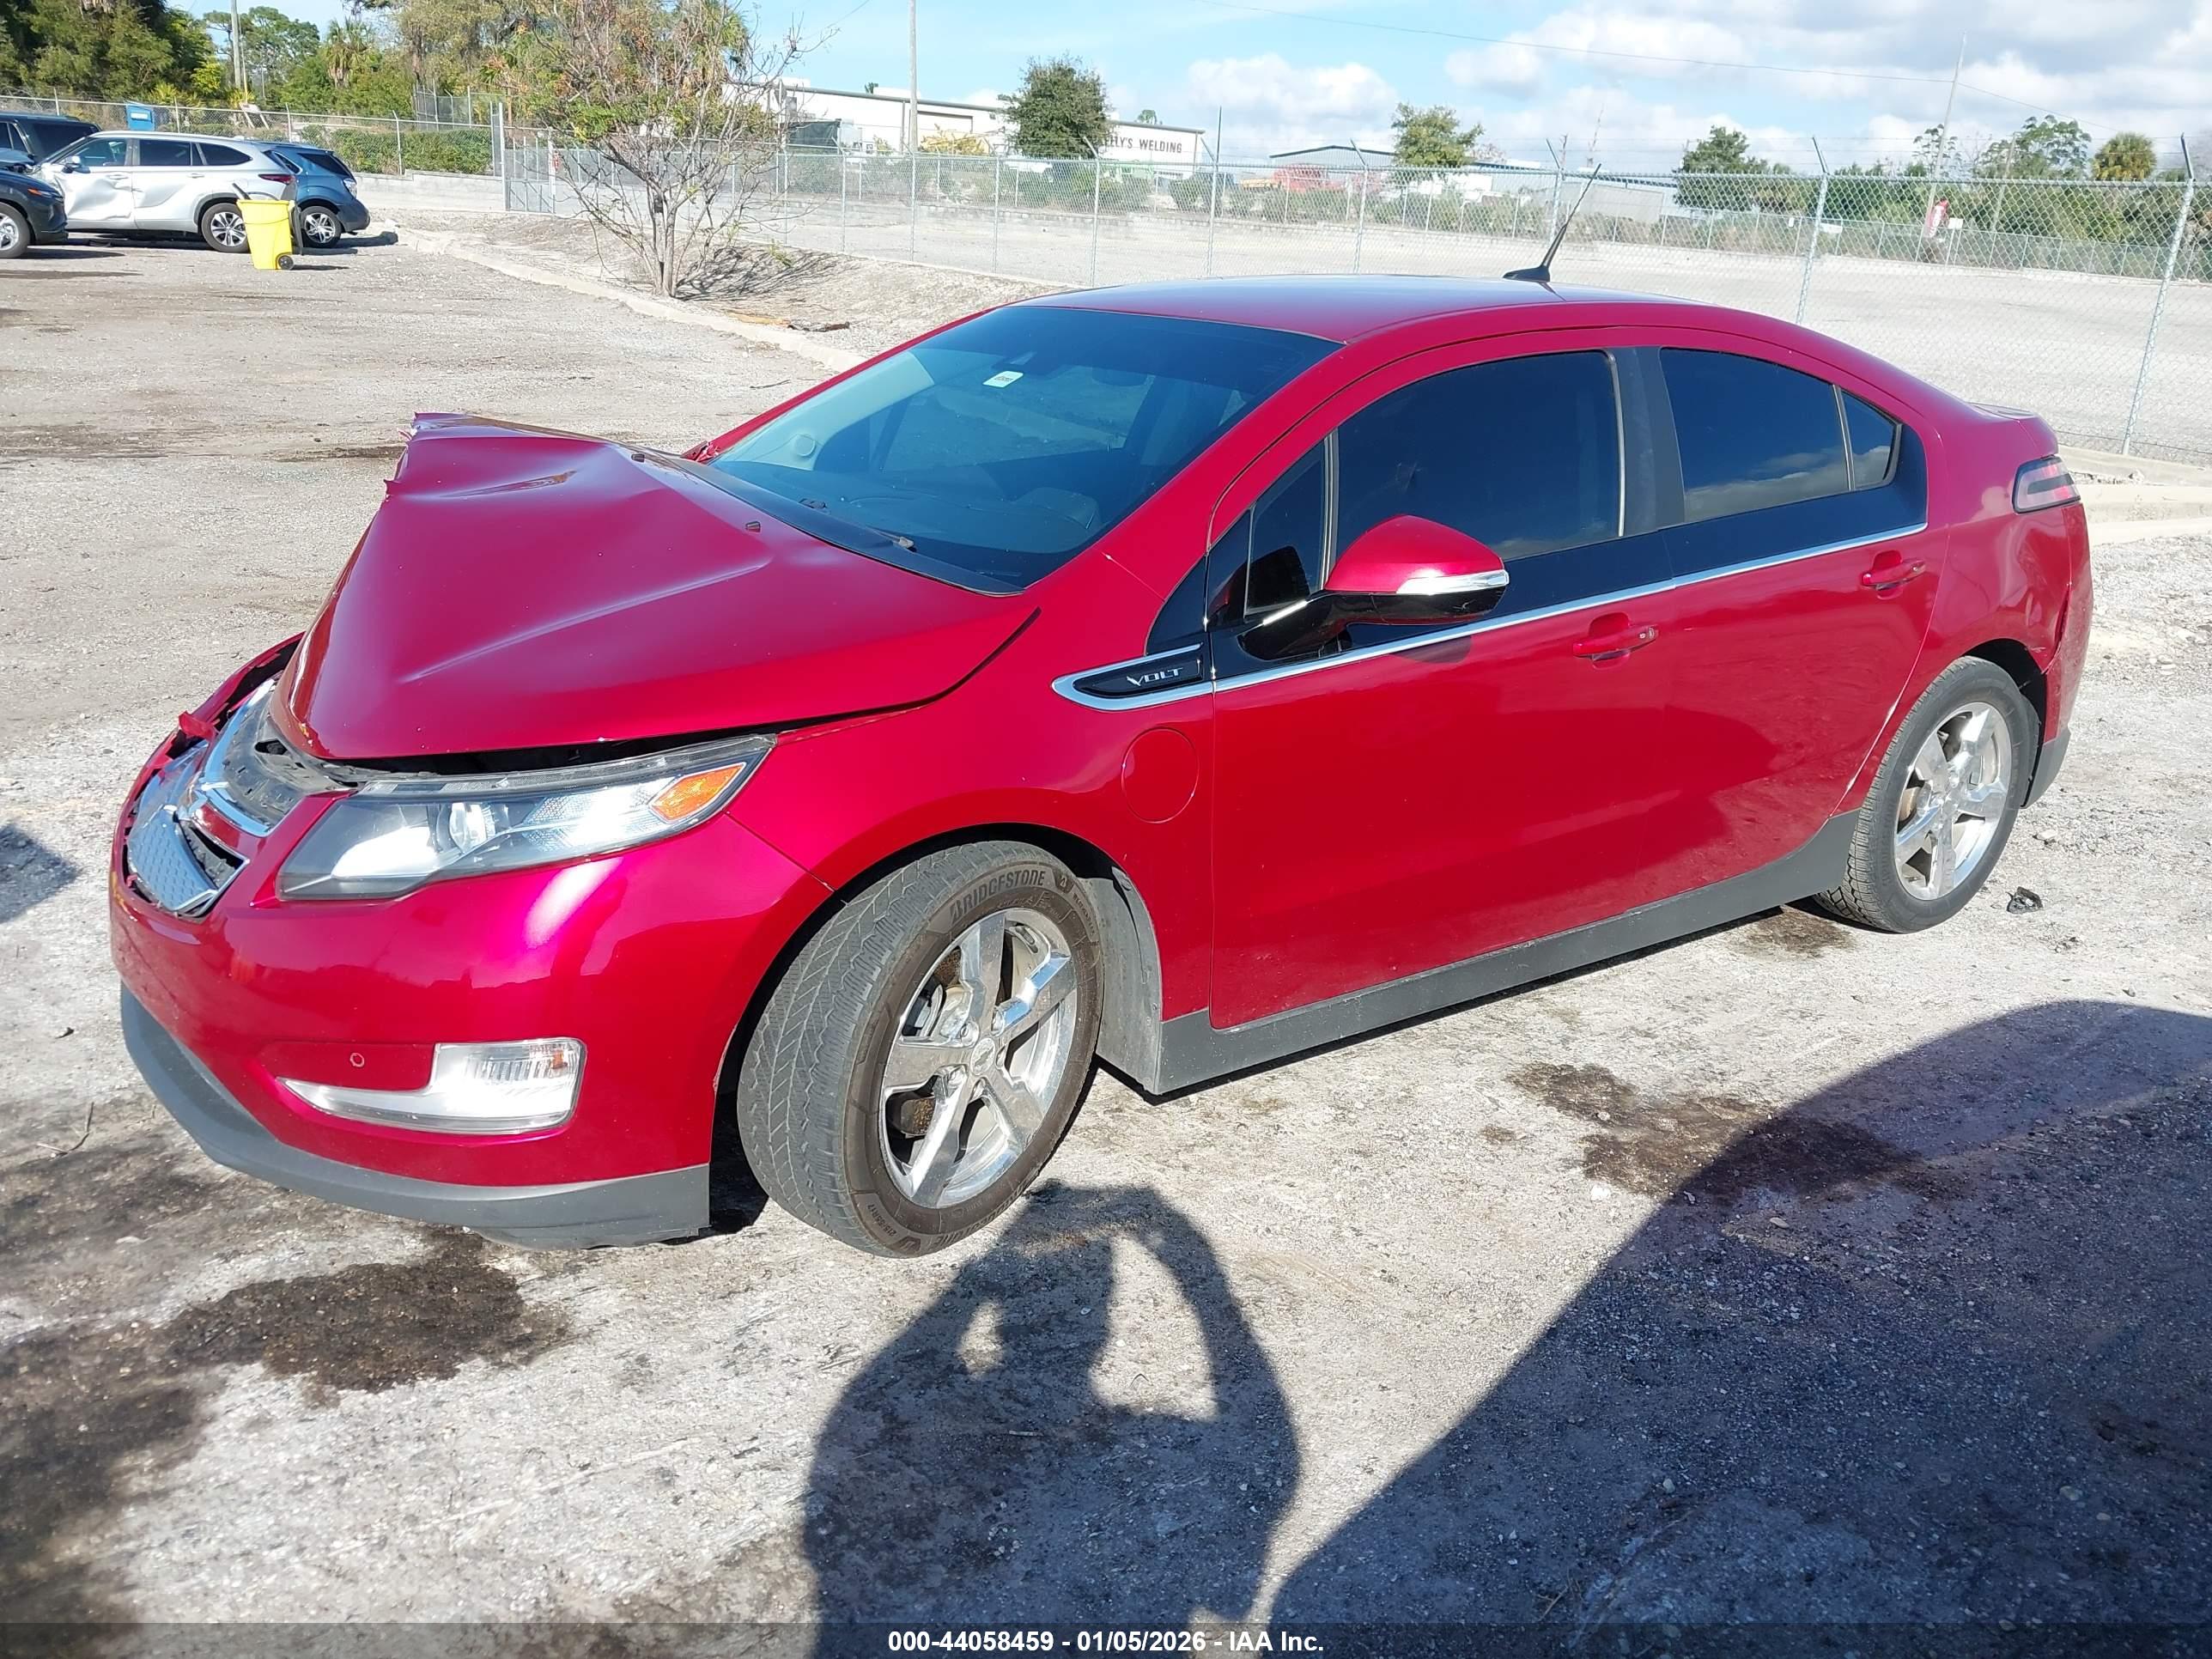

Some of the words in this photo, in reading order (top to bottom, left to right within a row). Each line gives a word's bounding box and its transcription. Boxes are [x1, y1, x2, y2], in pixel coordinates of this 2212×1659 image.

[1139, 138, 1182, 154] WELDING
[1127, 667, 1183, 686] VOLT
[949, 869, 1046, 924] BRIDGESTONE
